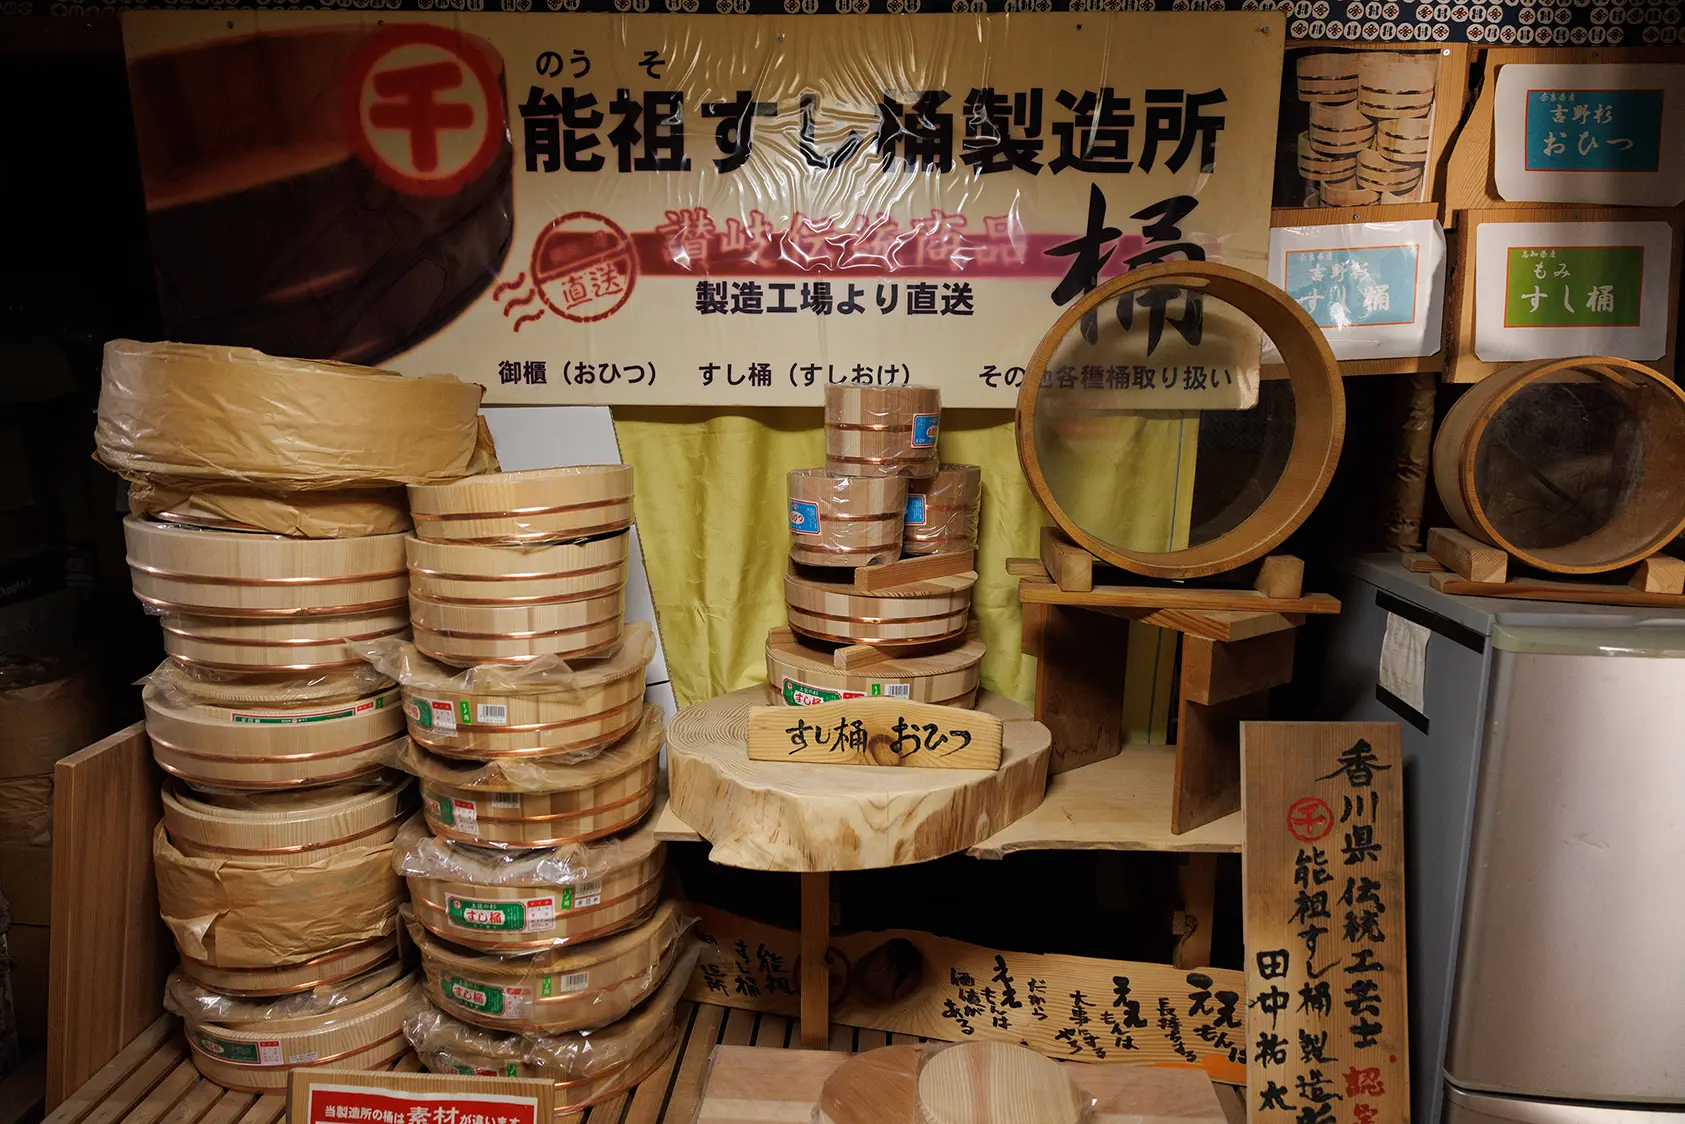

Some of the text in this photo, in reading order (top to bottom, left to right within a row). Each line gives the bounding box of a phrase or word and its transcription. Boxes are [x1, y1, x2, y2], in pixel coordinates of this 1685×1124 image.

[535, 48, 666, 79] のう そ
[517, 85, 1229, 175] 能祖すし桶製造所
[1549, 103, 1614, 125] 吉野杉
[1542, 130, 1634, 157] おひつ
[561, 262, 624, 310] 直送
[1043, 181, 1207, 358] 桶
[1533, 260, 1572, 280] もみ
[695, 280, 975, 316] 製造工場より直送
[1297, 284, 1391, 315] すし桶
[1520, 284, 1615, 314] すし桶
[784, 716, 973, 760] すし桶 おひつ
[1314, 738, 1393, 1050] 香川県伝統工芸士
